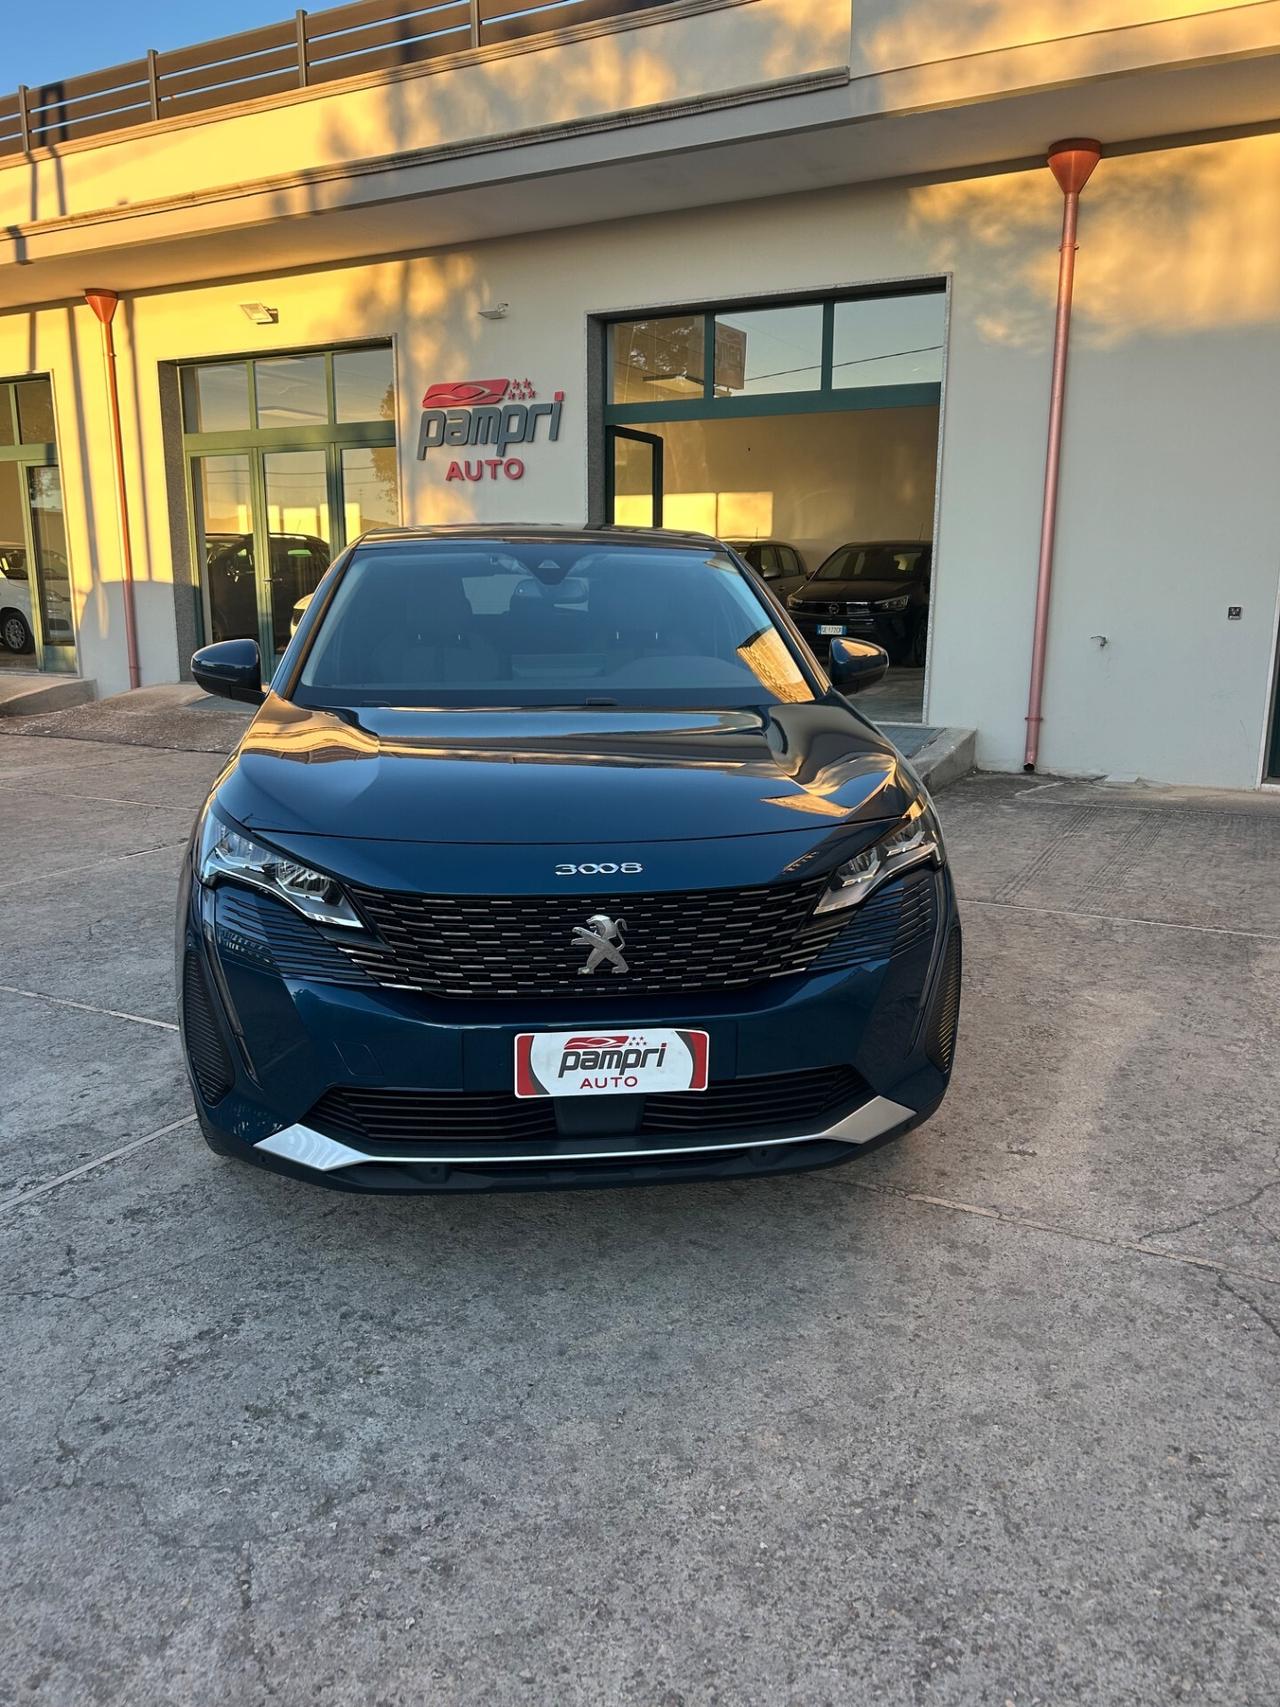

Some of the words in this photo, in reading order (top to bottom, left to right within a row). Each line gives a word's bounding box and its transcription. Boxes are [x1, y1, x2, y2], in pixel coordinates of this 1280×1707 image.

[416, 390, 565, 461] pampri
[445, 457, 525, 482] AUTO
[555, 862, 643, 875] 3008
[557, 1042, 668, 1079] pampri
[579, 1075, 638, 1090] AUTO
